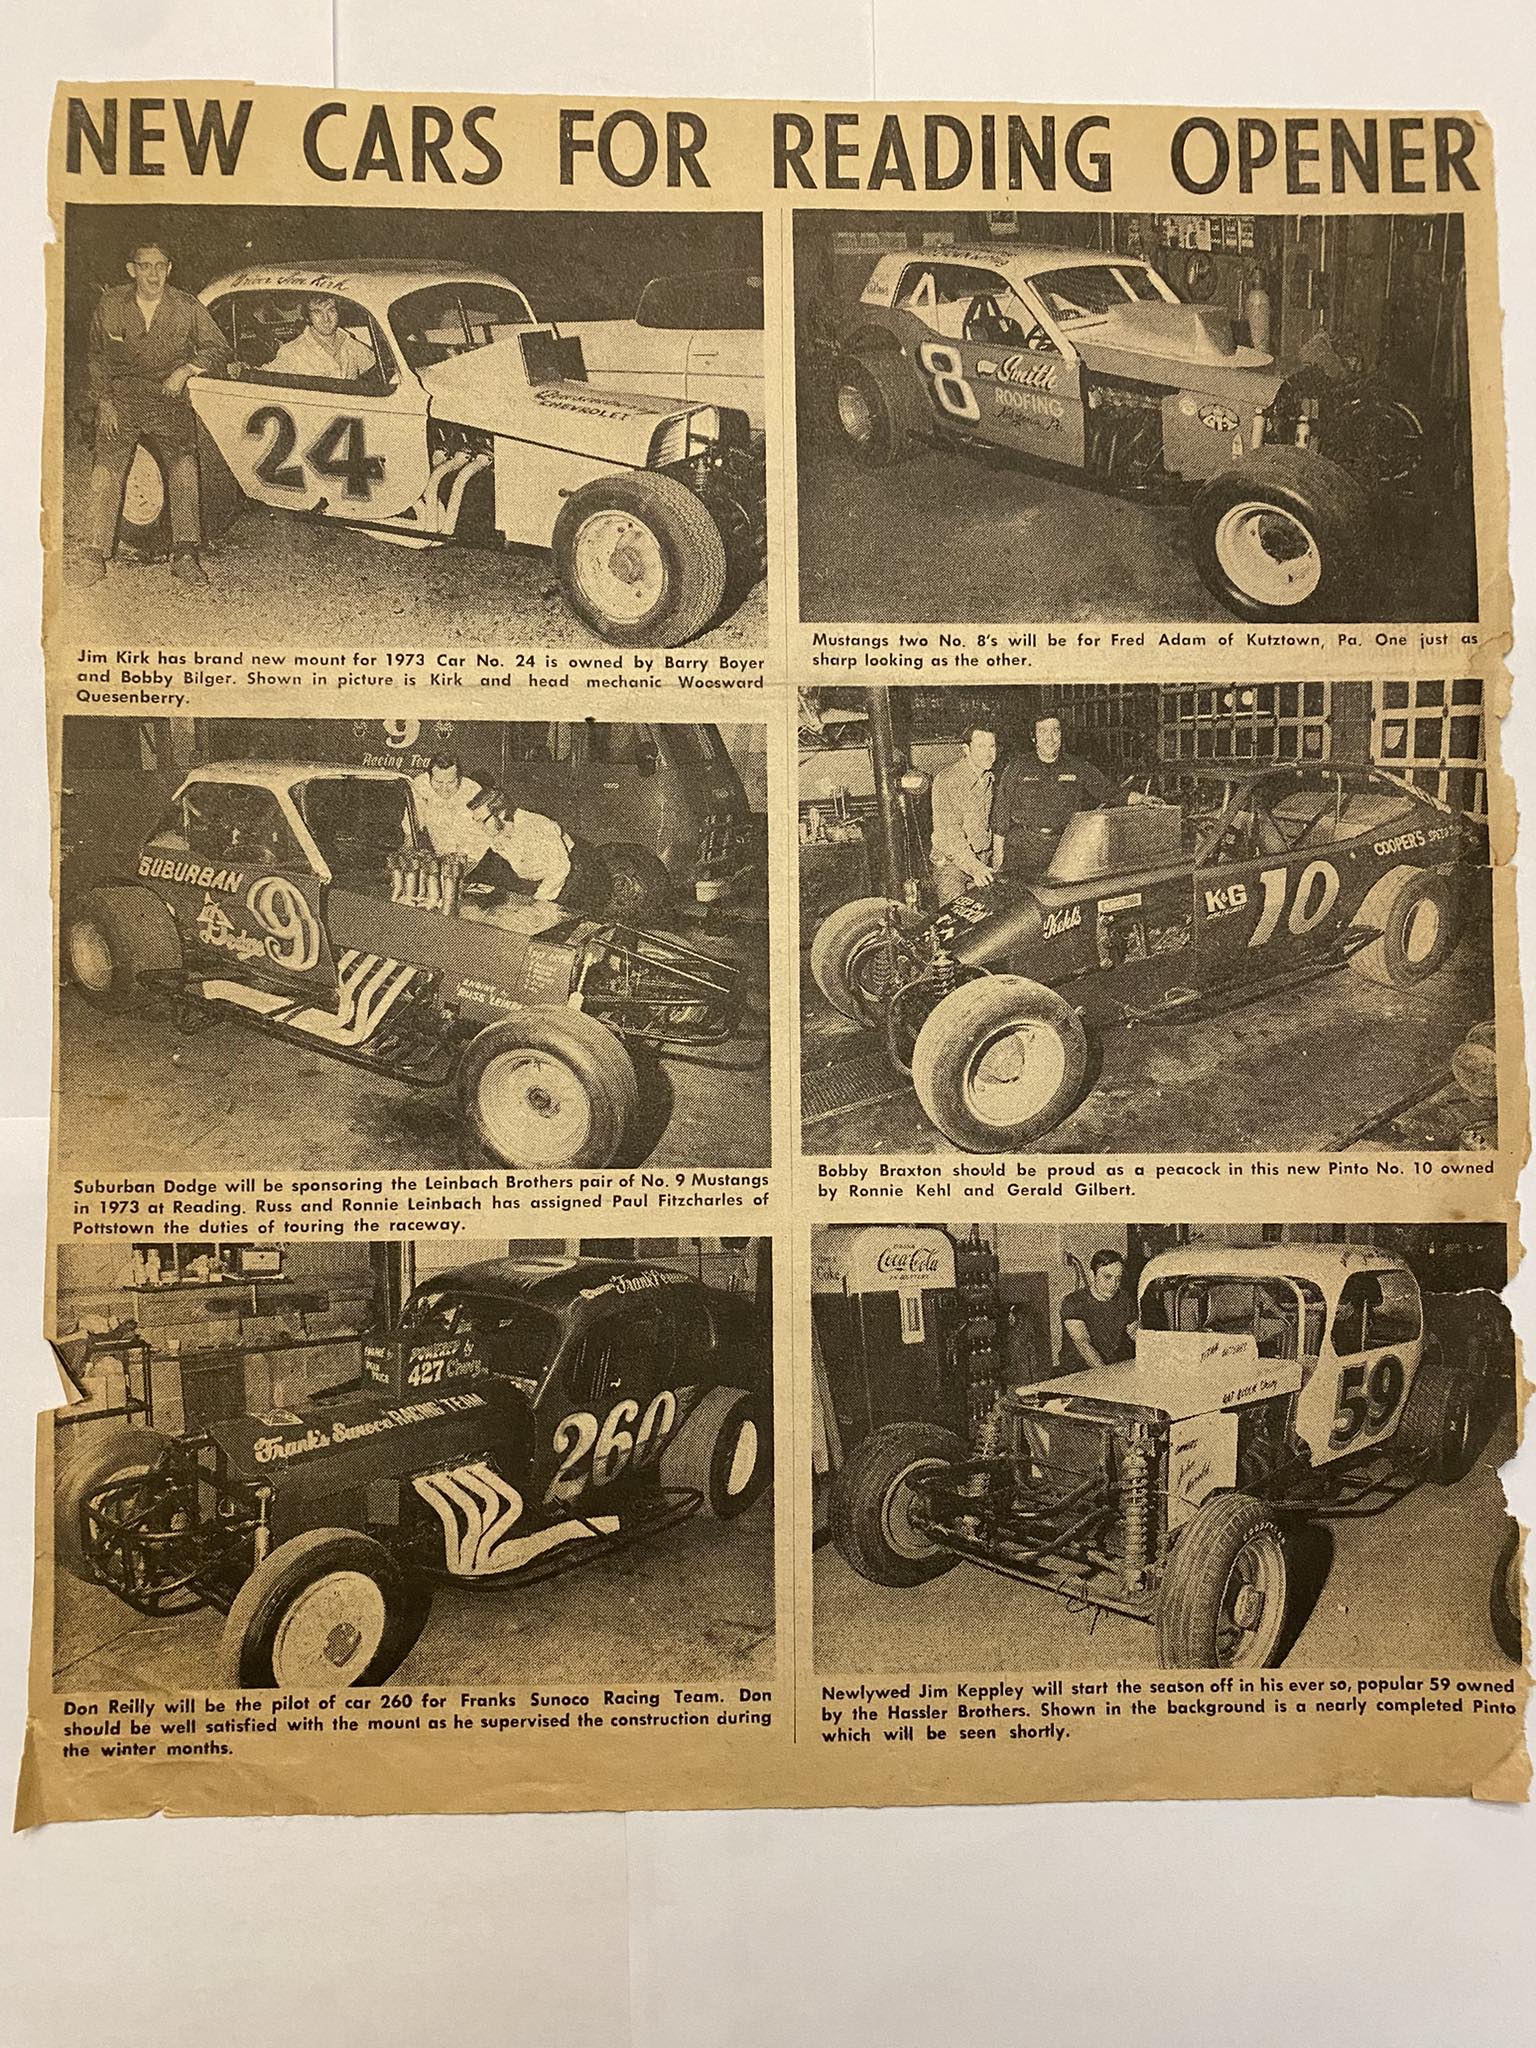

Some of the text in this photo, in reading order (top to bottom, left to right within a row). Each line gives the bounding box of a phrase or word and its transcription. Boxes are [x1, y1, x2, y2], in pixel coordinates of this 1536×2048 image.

[65, 97, 1481, 196] NEW CARS FOR READING OPENER
[918, 341, 981, 423] 8
[997, 354, 1057, 390] Smith
[538, 401, 632, 421] CHEVROLET
[995, 387, 1064, 418] ROOFING
[243, 405, 387, 502] 24
[812, 632, 1479, 650] Mustangs two No. 8's will be for Fred Adam of Kutztown, Pa. One just as
[77, 649, 765, 673] Jim Kirk has brand new mount for 1973 Car No. 24 is owned by Barry Boyer
[75, 688, 190, 708] Quesenberry.
[362, 752, 404, 769] Racing
[1374, 830, 1426, 856] COOPER'S
[138, 856, 244, 893] SUBURBAN
[1205, 884, 1248, 913] K&G
[1248, 860, 1340, 948] 10
[247, 876, 320, 972] 9
[199, 922, 266, 961] Dodge
[73, 1172, 769, 1197] Suburban Dodge will be sponsoring the Leinbach Brothers pair of No. 9 Mustangs
[818, 1158, 1494, 1182] Bobby Braxton should be proud as a peacock in this new Pinto No. 10 owned
[73, 1217, 466, 1236] Pottstown the duties of touring the raceway.
[817, 1265, 841, 1281] Coke
[408, 1360, 445, 1387] 427
[1328, 1354, 1405, 1450] 59
[254, 1430, 331, 1463] Frank's
[440, 1393, 487, 1412] TEAM
[543, 1390, 677, 1503] 260
[63, 1687, 772, 1718] Don Reilly will be the pilot of car 260 for Franks Sunoco Racing Team. Don
[822, 1674, 1515, 1704] Newlywed Jim Keppley will start the season off in his ever so, popular 59 owned
[821, 1722, 1071, 1743] which will be seen shortly.
[62, 1739, 234, 1758] the winter months.
